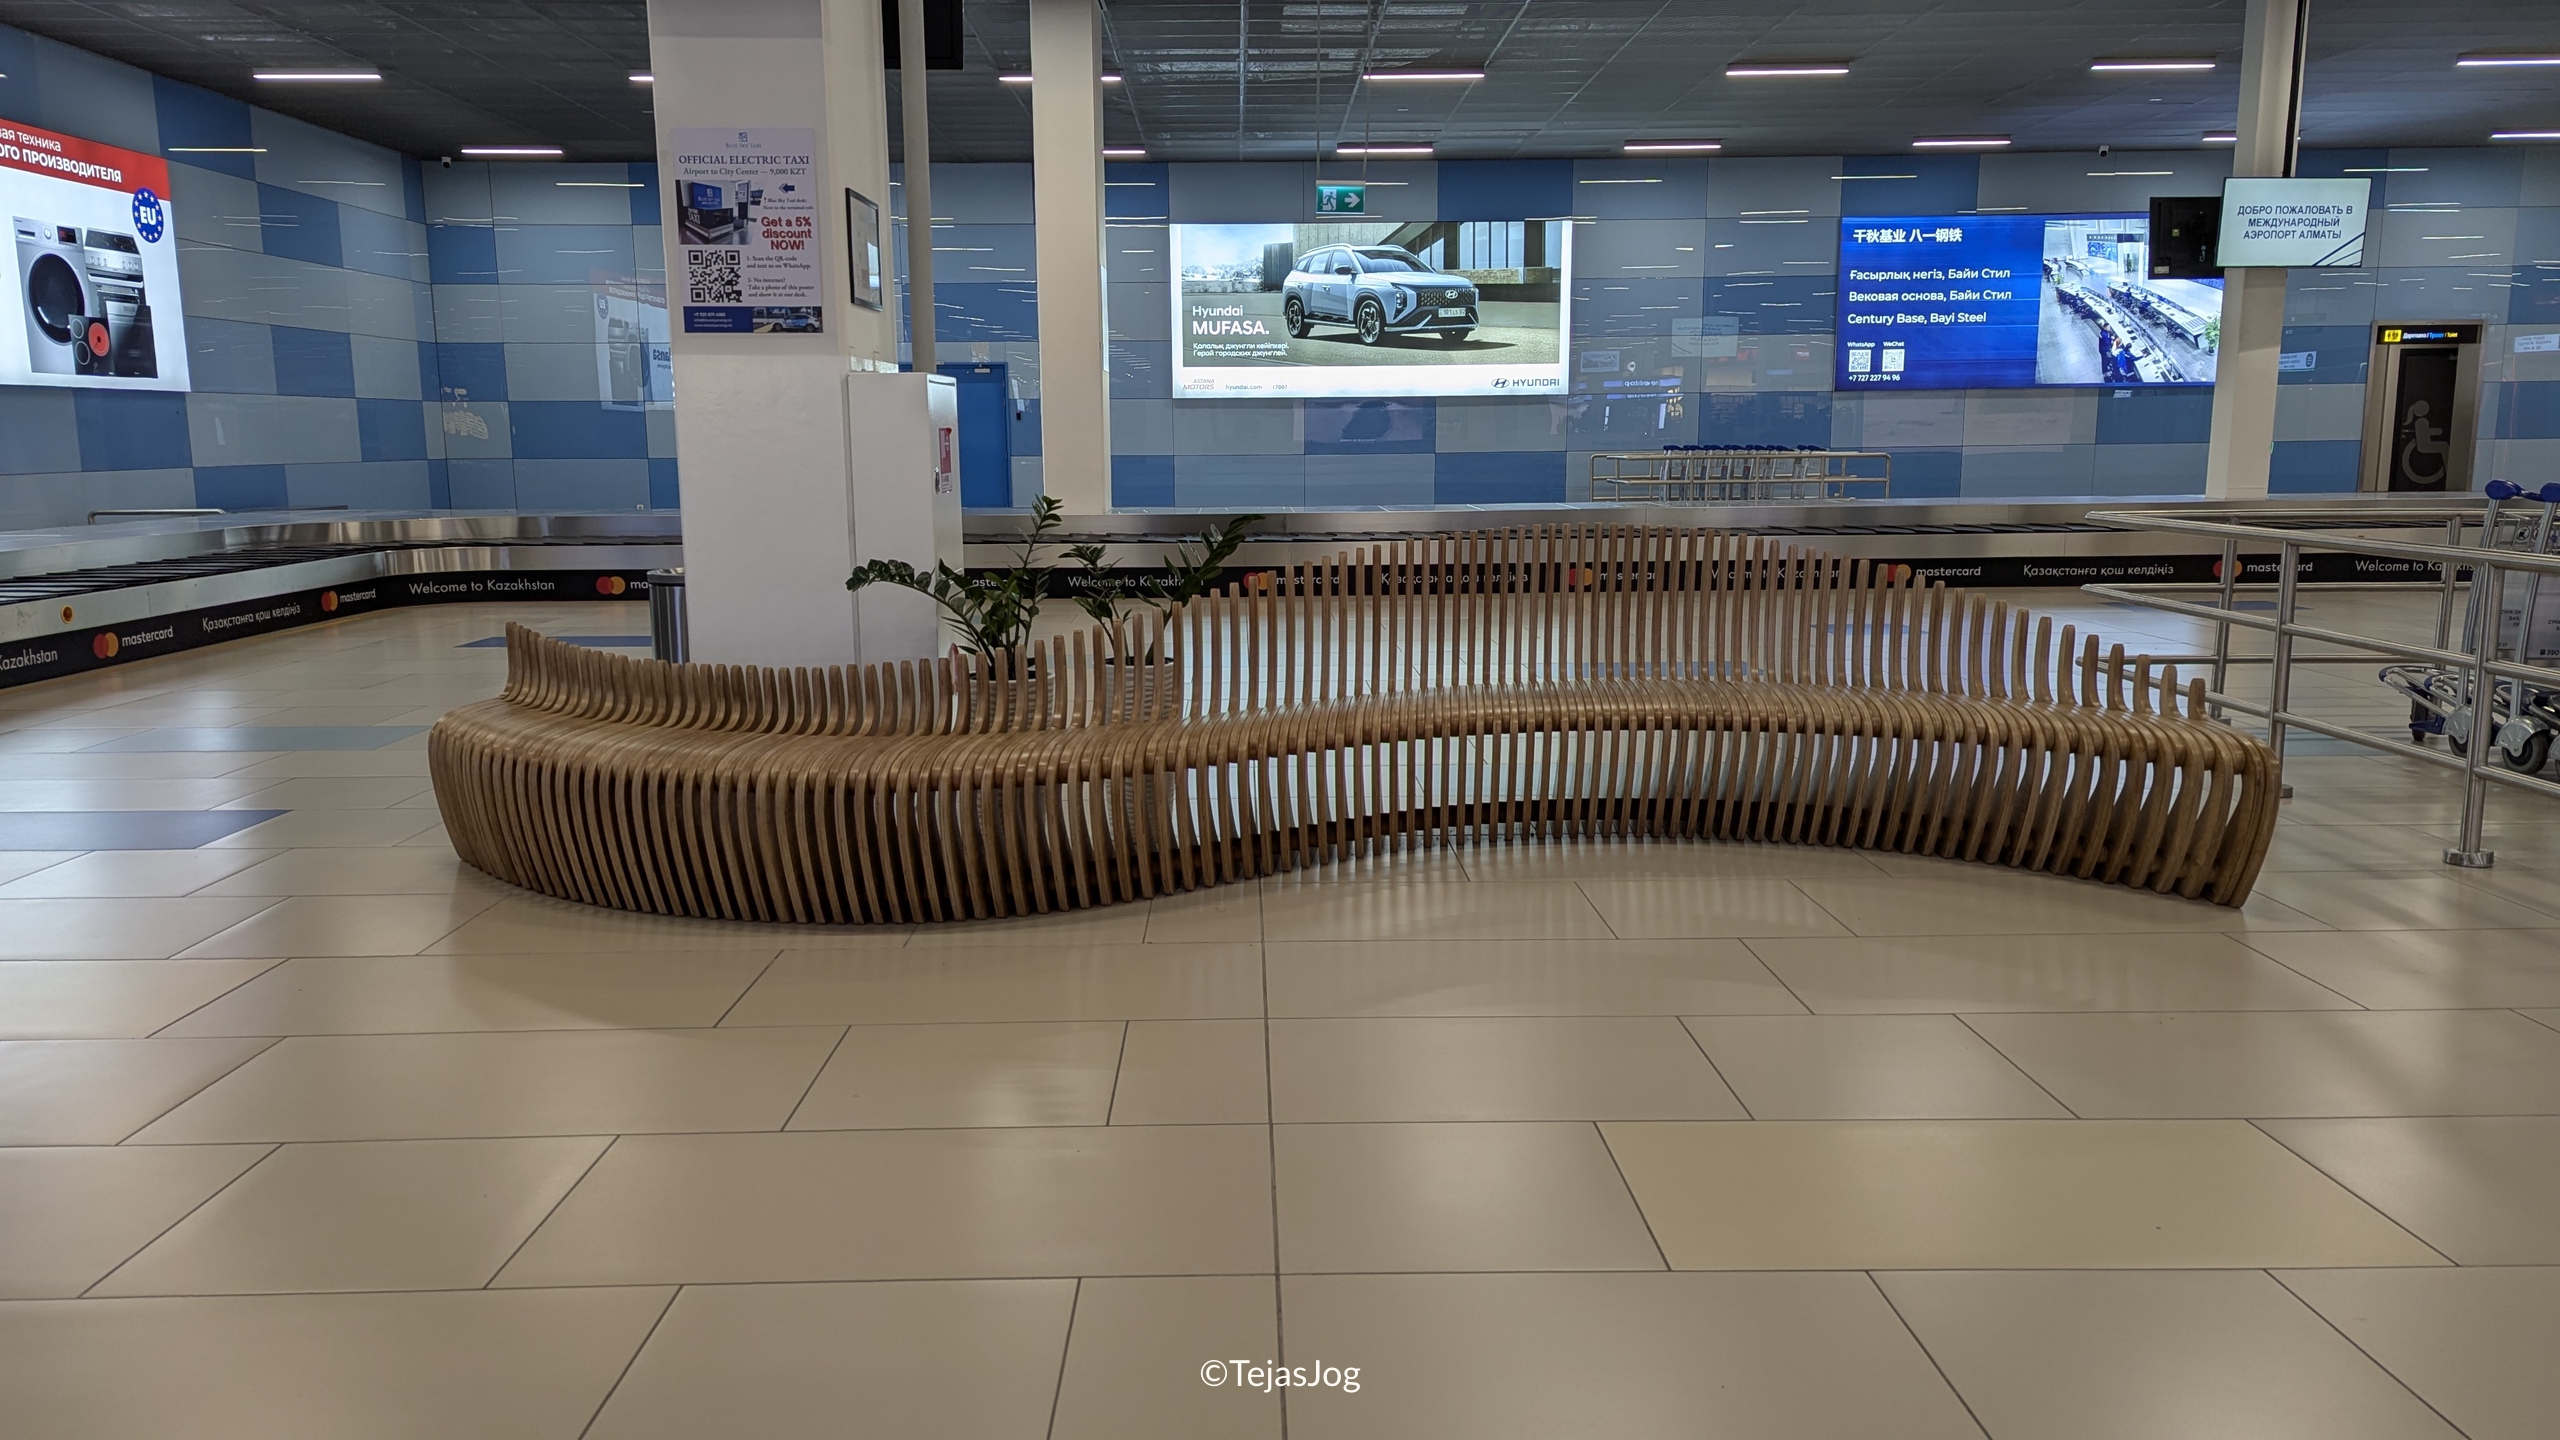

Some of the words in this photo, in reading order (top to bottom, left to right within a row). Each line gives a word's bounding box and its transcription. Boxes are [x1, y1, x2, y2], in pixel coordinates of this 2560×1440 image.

[16, 131, 61, 152] техника
[22, 148, 122, 183] ПРОИЗВОДИТЕЛЯ
[678, 155, 728, 165] OFFICIAL
[729, 155, 782, 165] ELECTRIC
[783, 155, 810, 165] TAXI
[683, 168, 710, 177] Airport
[720, 168, 734, 177] City
[770, 168, 788, 176] 9,000
[140, 206, 156, 225] EU
[2236, 206, 2272, 216] ДОБРО
[2274, 206, 2344, 215] ПОЖАЛОВАТЬ
[2346, 206, 2353, 214] В
[761, 216, 782, 227] Get
[785, 219, 792, 227] a
[795, 216, 812, 227] 5%
[2248, 216, 2340, 228] МЕЖДУНАРОДНЫЙ
[762, 228, 812, 239] discount
[1852, 228, 1906, 243] 千秋基业
[1908, 228, 1963, 243] 八一钢铁
[2242, 230, 2297, 239] АЭРОПОРТ
[2298, 230, 2342, 239] АЛМАТЫ
[770, 240, 805, 250] NOW!
[1850, 270, 1911, 282] Ғасырлық
[1912, 268, 1946, 280] негіз,
[1948, 268, 1978, 279] Байи
[1982, 269, 2011, 278] Стил
[1848, 292, 1898, 302] Вековая
[1901, 292, 1946, 302] основа,
[1950, 290, 1980, 300] Байи
[1982, 290, 2012, 300] Стил
[1192, 304, 1244, 318] Hyundai
[1847, 314, 1894, 326] Century
[1896, 313, 1928, 324] Base,
[1930, 312, 1955, 325] Bayi
[1957, 312, 1987, 323] Steel
[1192, 320, 1270, 335] MUFASA.
[1512, 378, 1560, 387] HYUNDAI
[1916, 566, 1981, 577] mastercard
[2023, 564, 2098, 578] Қазақстанға
[2100, 566, 2125, 577] қош
[2128, 564, 2174, 577] келдіңіз
[2355, 560, 2410, 572] Welcome
[2412, 562, 2424, 572] to
[408, 581, 468, 594] Welcome
[470, 582, 484, 592] to
[486, 578, 555, 591] Kazakhstan
[340, 588, 376, 604] mastercard
[202, 616, 254, 633] Қазақстанға
[256, 611, 271, 623] қош
[272, 602, 301, 618] келдіңіз
[122, 626, 174, 647] mastercard
